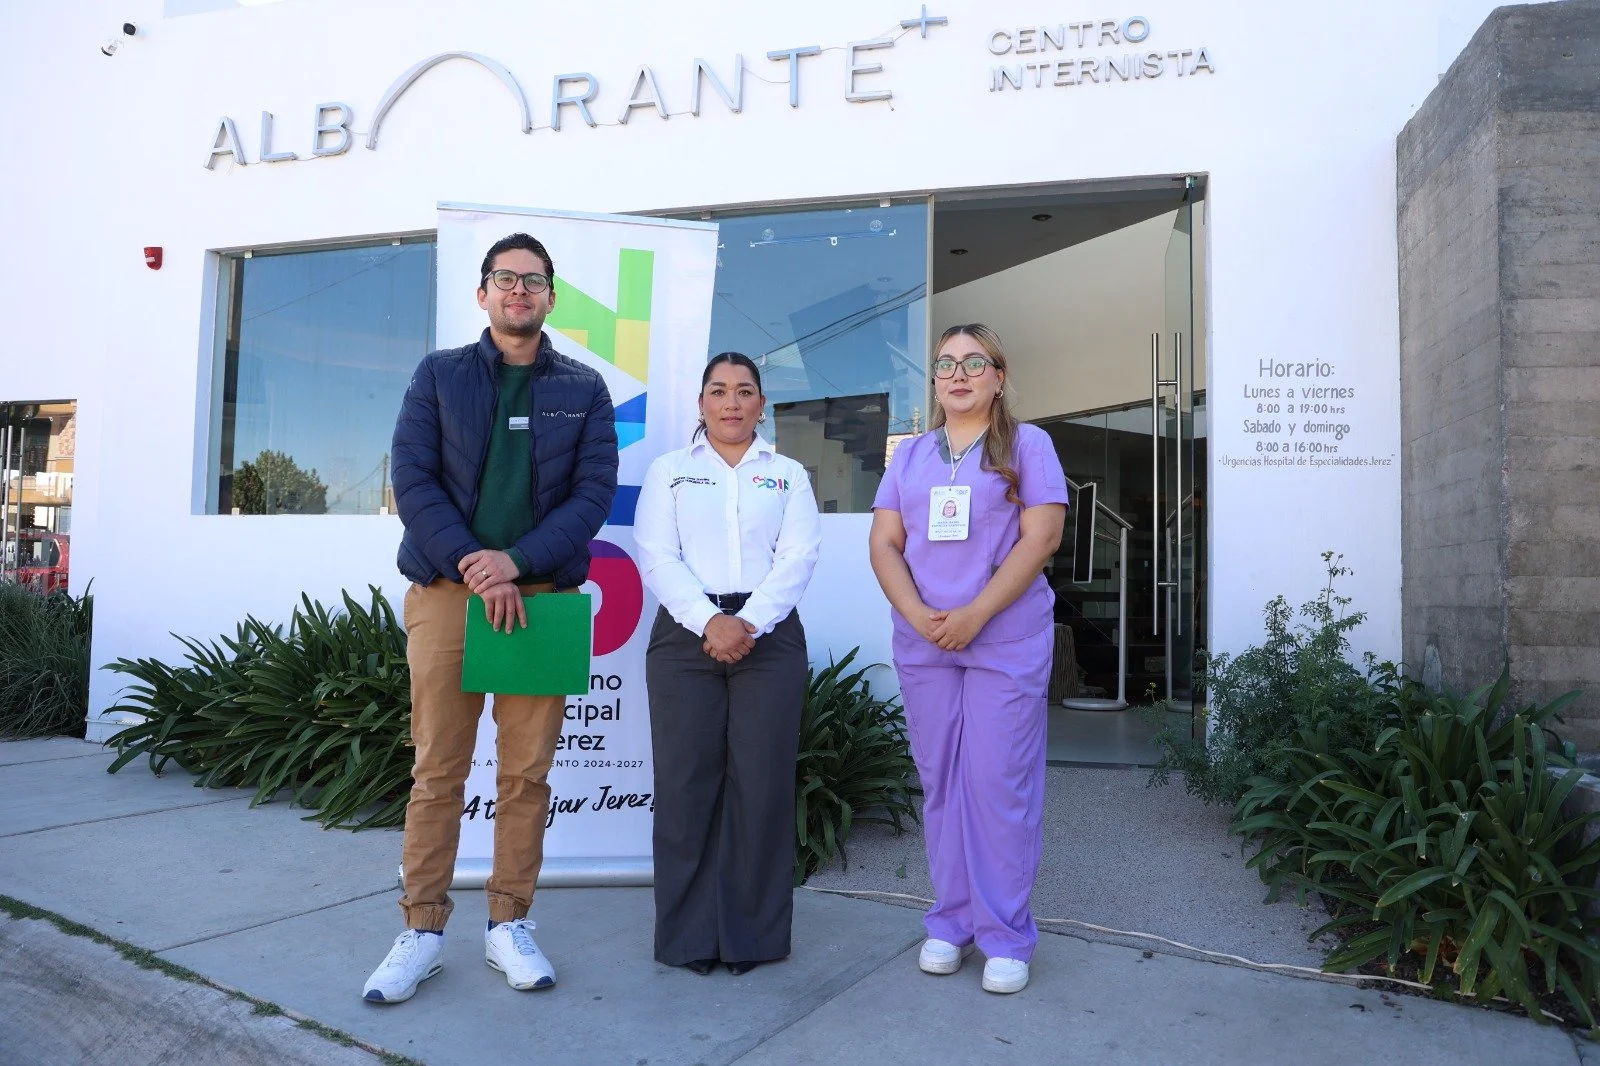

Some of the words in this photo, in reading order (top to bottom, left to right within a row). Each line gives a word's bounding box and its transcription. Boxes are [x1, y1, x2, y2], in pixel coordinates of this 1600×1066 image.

[987, 15, 1150, 55] CENTRO
[989, 47, 1215, 92] INTERNISTA
[1259, 358, 1335, 377] Horario:
[1243, 384, 1280, 398] Lunes
[1287, 388, 1294, 398] a
[1302, 384, 1355, 398] viernes
[1256, 403, 1280, 413] 8:00
[1287, 404, 1294, 413] a
[1300, 403, 1327, 413] 19:00
[1330, 406, 1345, 414] hrs
[1243, 420, 1281, 433] Sabado
[1288, 423, 1296, 436] y
[1303, 420, 1350, 440] domingo
[1256, 441, 1279, 452] 8:00
[1282, 443, 1289, 452] a
[1294, 442, 1322, 453] 16:00
[1324, 444, 1338, 453] hrs
[1297, 456, 1307, 466] de
[1309, 455, 1368, 468] Especialidades
[563, 697, 620, 728] cipal
[556, 734, 605, 751] erez
[584, 760, 643, 768] 2024-2027
